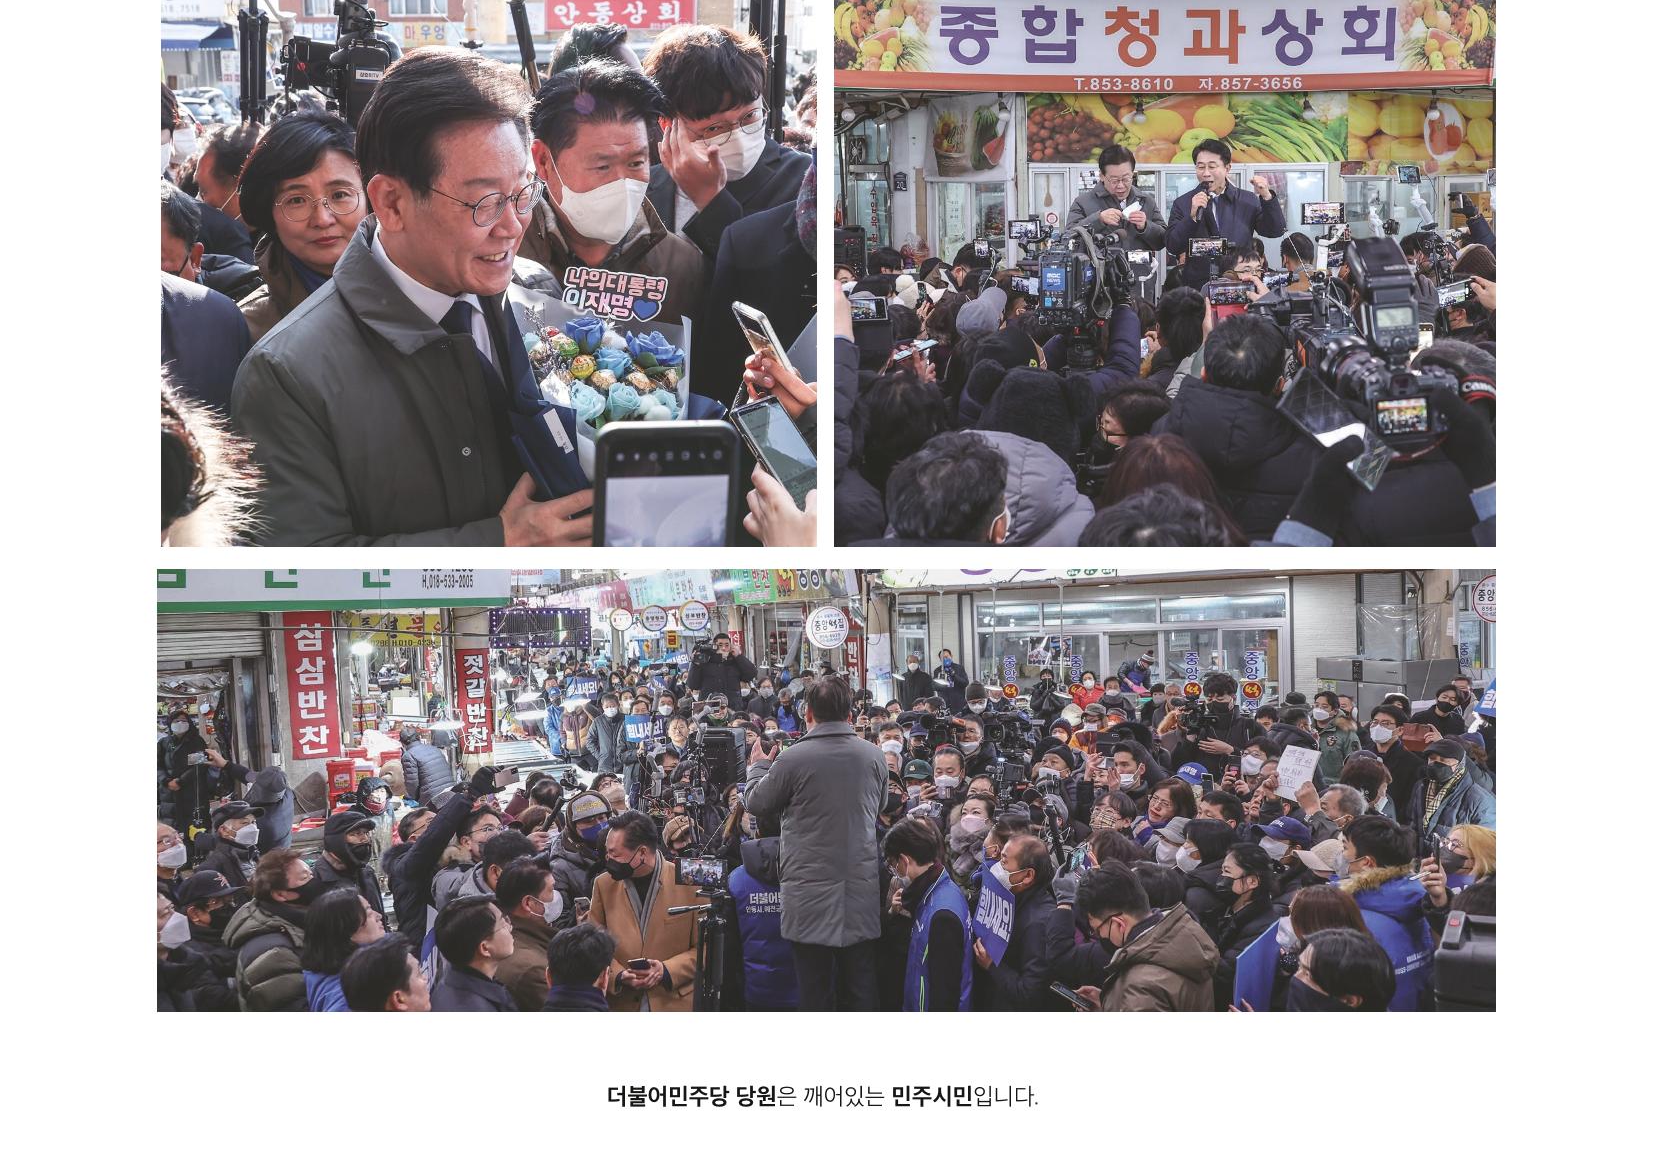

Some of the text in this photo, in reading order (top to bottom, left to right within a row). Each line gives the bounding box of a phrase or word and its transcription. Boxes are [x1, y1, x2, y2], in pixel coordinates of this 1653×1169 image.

[553, 1, 680, 25] 안동상회
[1075, 75, 1303, 91] T.853-8610 자.857-3656
[567, 268, 666, 300] 나의대통령
[565, 288, 632, 317] 이재명
[976, 885, 1013, 942] 힘내세요!
